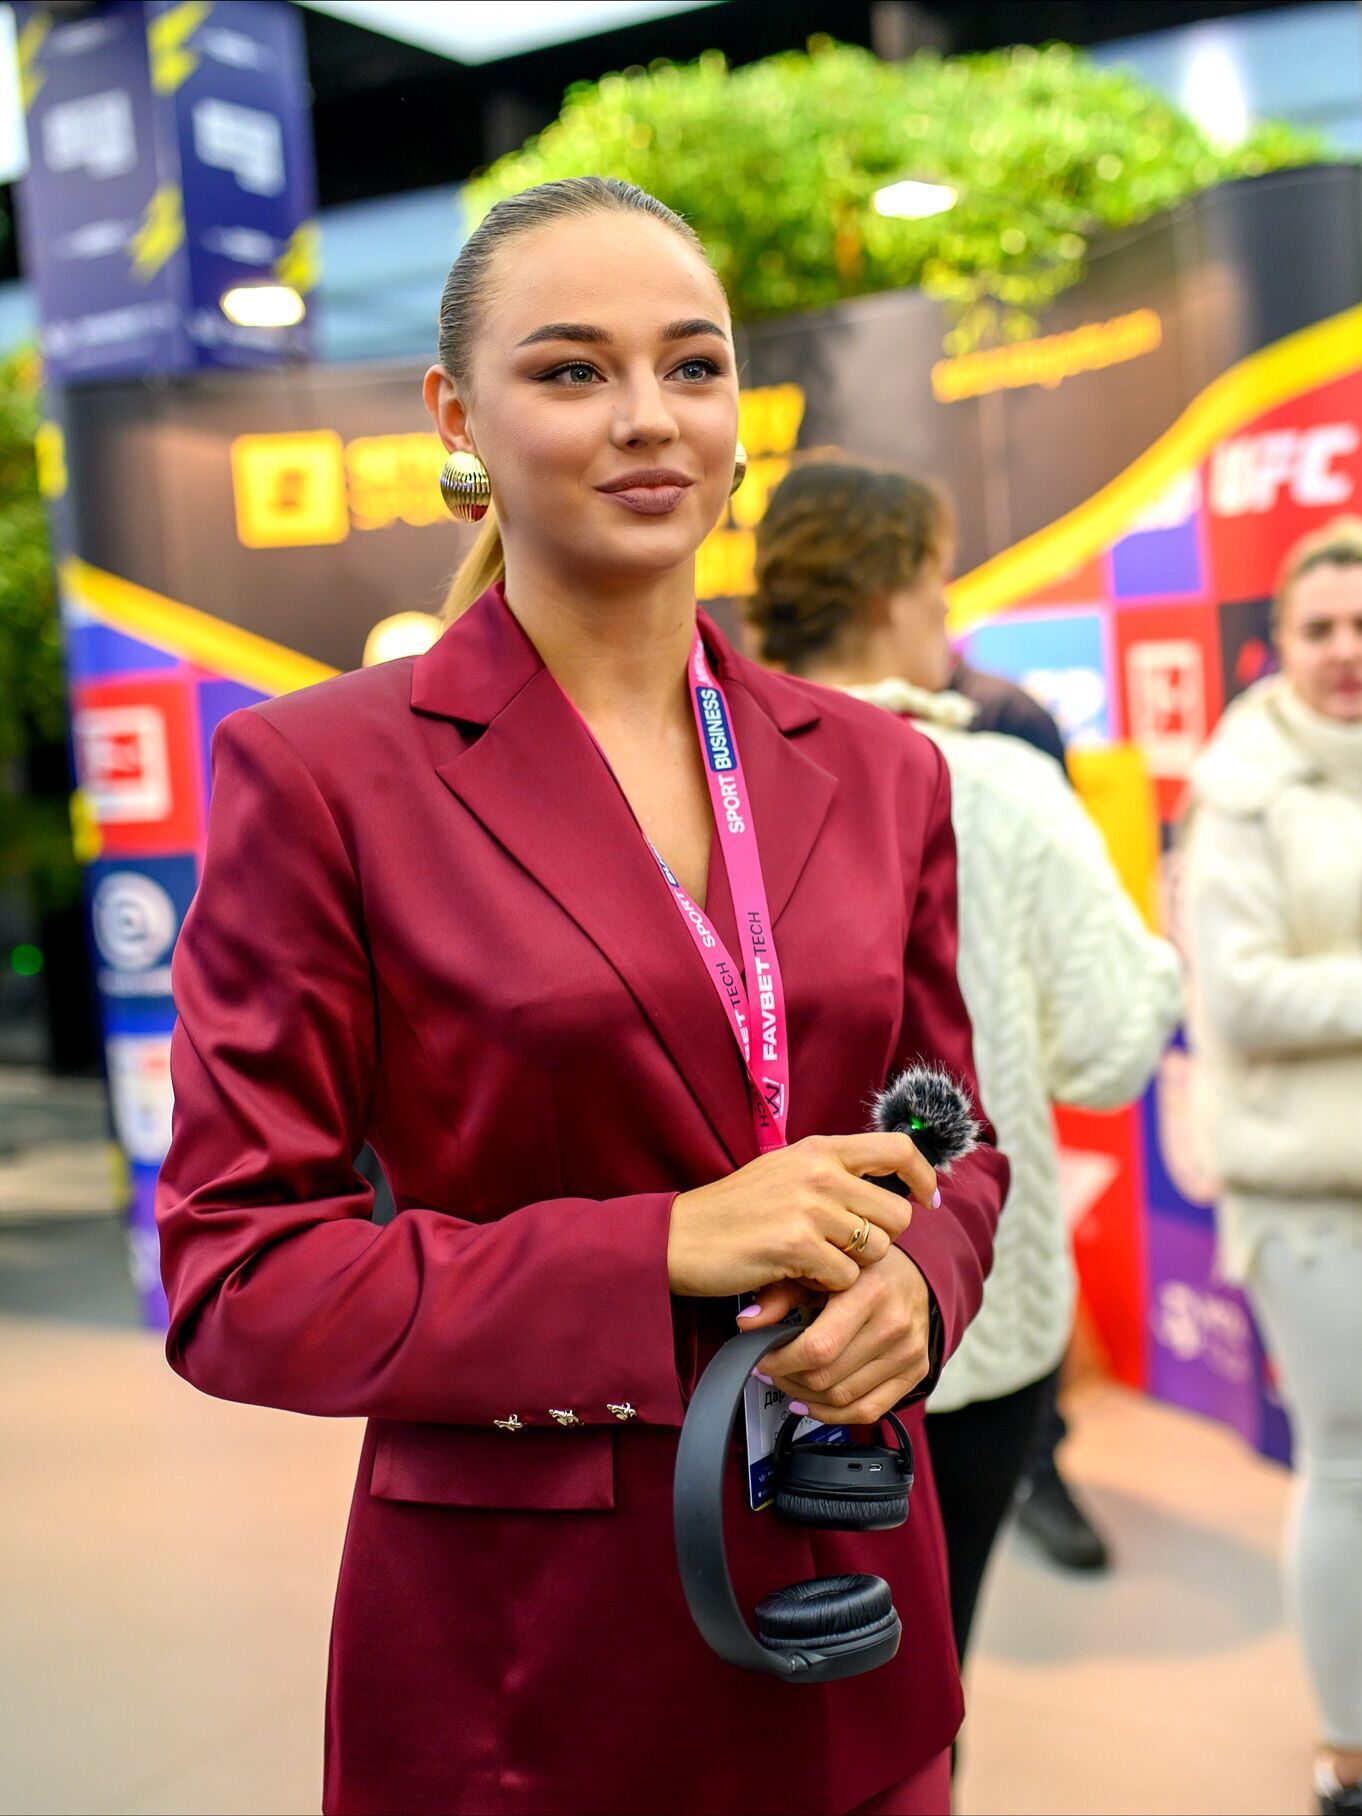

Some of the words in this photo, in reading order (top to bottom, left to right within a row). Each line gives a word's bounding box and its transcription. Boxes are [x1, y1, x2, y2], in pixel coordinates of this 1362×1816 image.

[1209, 425, 1358, 517] UFC
[701, 688, 732, 770] BUSINESS
[718, 775, 745, 834] SPORT
[675, 890, 716, 948] SPORT
[747, 911, 766, 957] TECH
[716, 962, 741, 1009] TECH
[755, 957, 778, 1062] FAVBET
